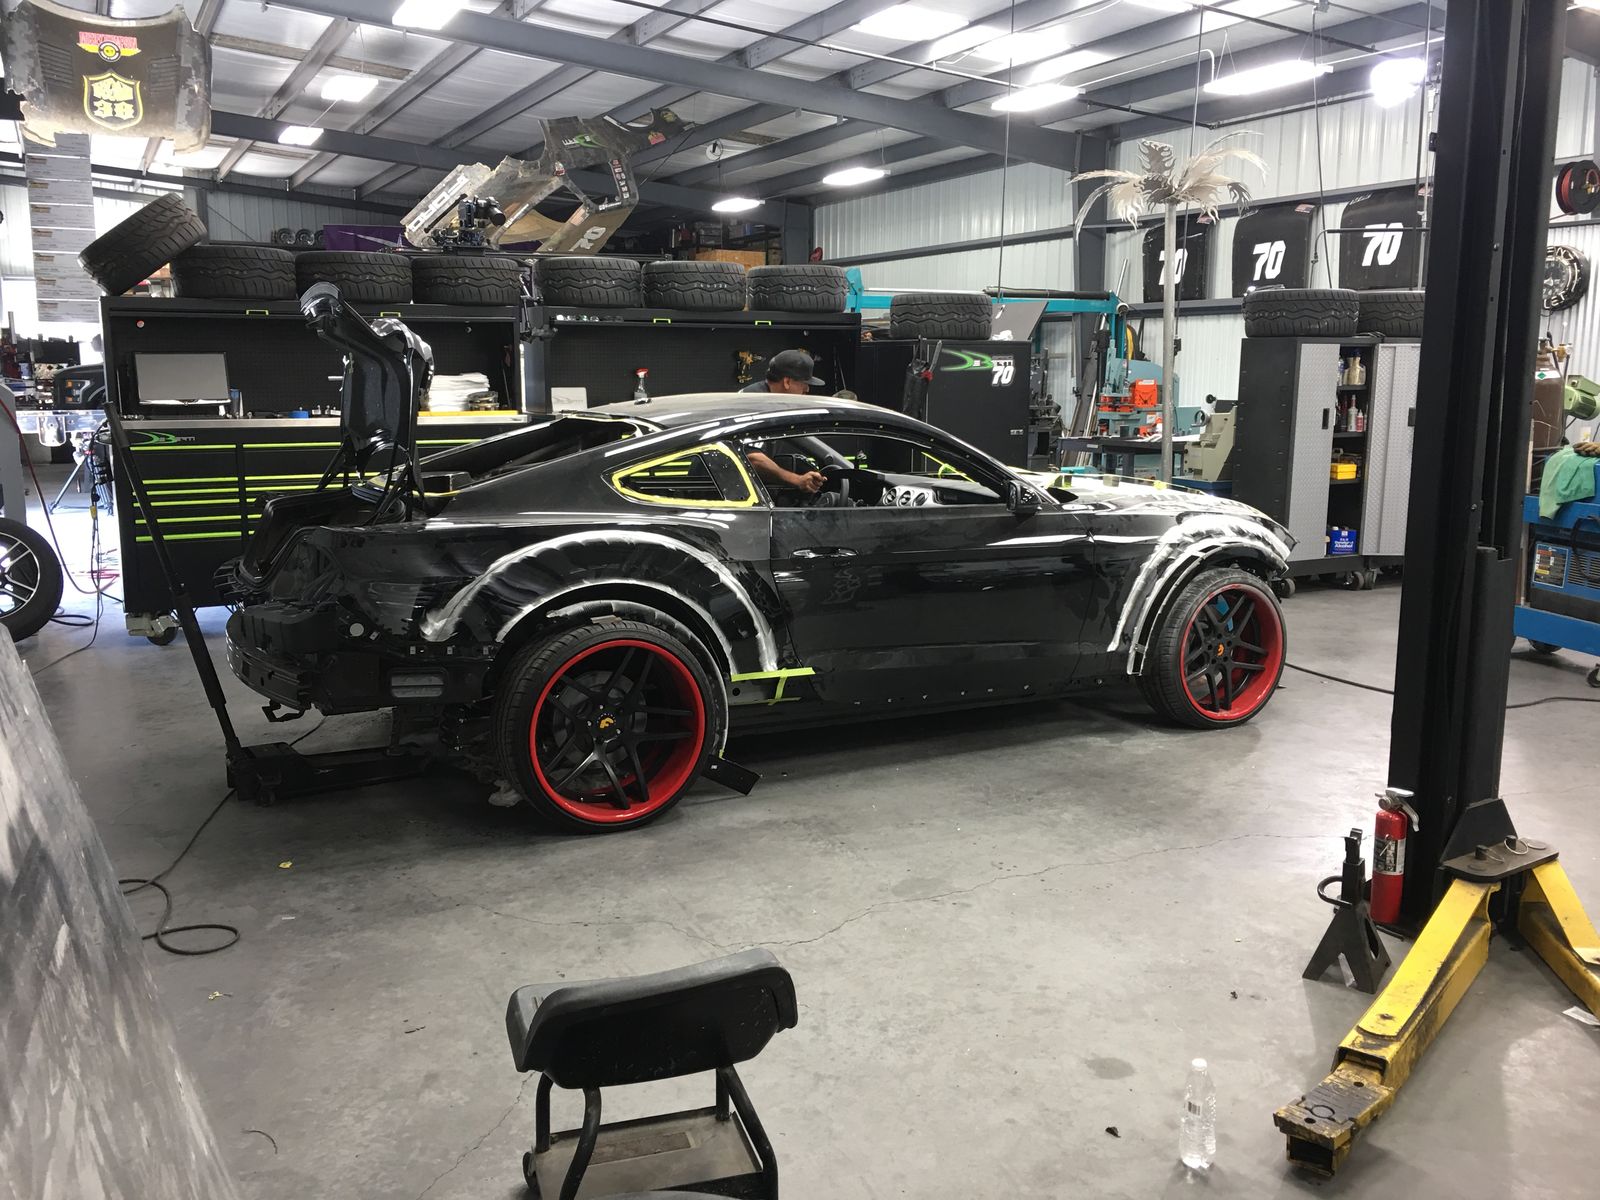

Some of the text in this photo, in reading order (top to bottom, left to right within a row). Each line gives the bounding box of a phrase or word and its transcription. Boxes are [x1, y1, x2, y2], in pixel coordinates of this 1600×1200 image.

[1253, 240, 1287, 281] 70
[1362, 222, 1404, 266] 70
[991, 366, 1014, 385] 70
